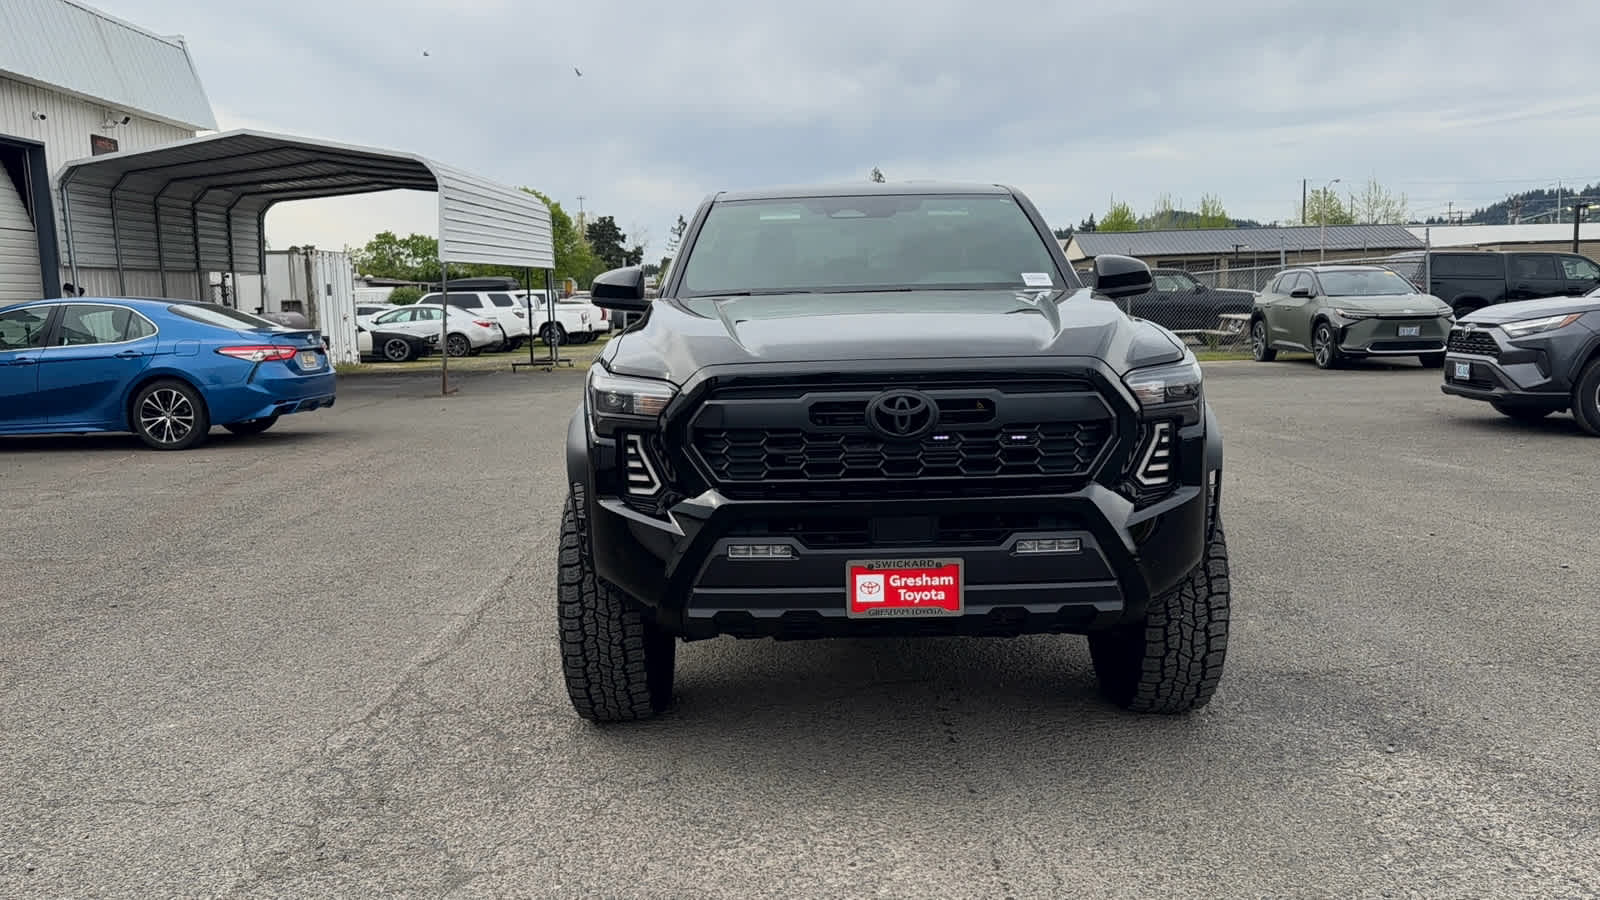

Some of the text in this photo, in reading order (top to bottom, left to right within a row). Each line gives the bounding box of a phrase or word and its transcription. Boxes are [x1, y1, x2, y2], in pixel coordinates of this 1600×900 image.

[875, 560, 934, 569] SWICKARD
[889, 573, 954, 587] Gresham
[898, 589, 945, 604] Toyota
